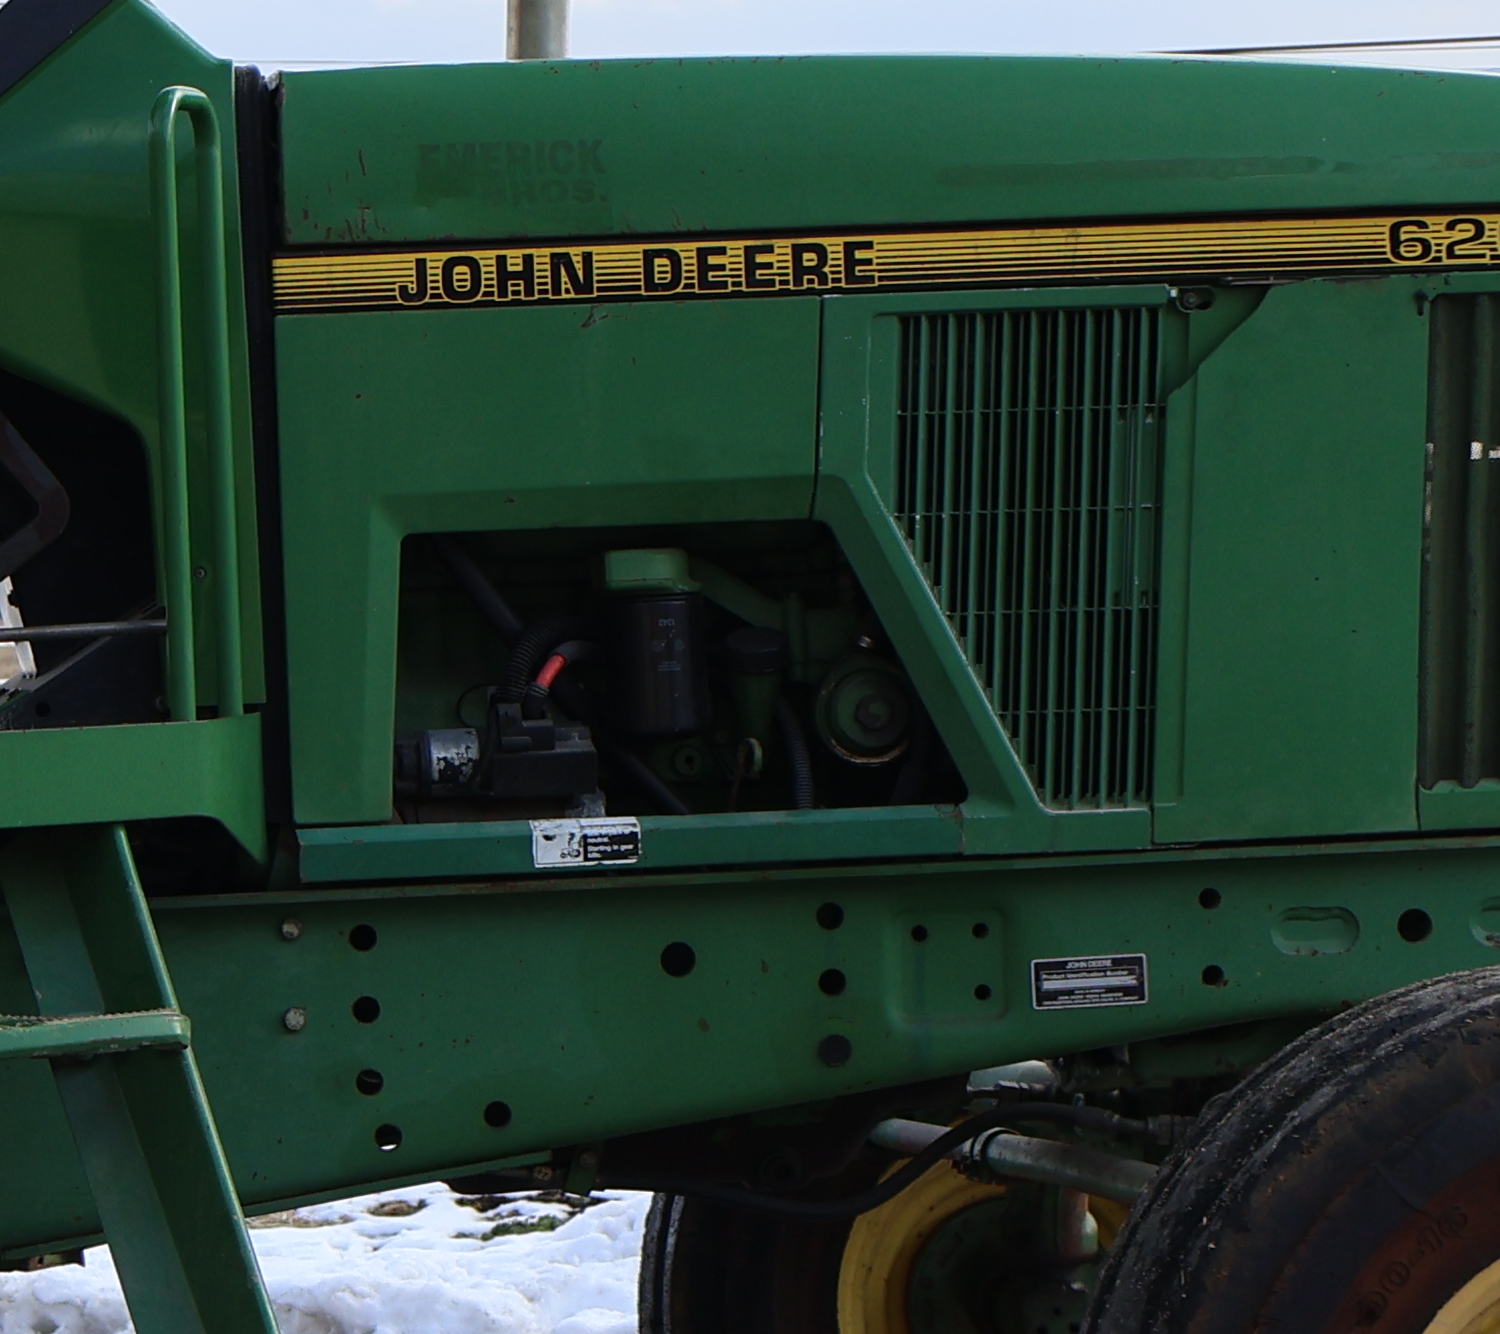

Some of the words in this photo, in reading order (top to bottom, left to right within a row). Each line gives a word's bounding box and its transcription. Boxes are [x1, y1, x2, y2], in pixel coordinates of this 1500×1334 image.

[417, 139, 606, 177] EMERICK
[396, 250, 597, 304] JOHN
[643, 240, 878, 296] DEERE
[1066, 960, 1087, 969] JOHN
[1088, 959, 1113, 968] DEERE
